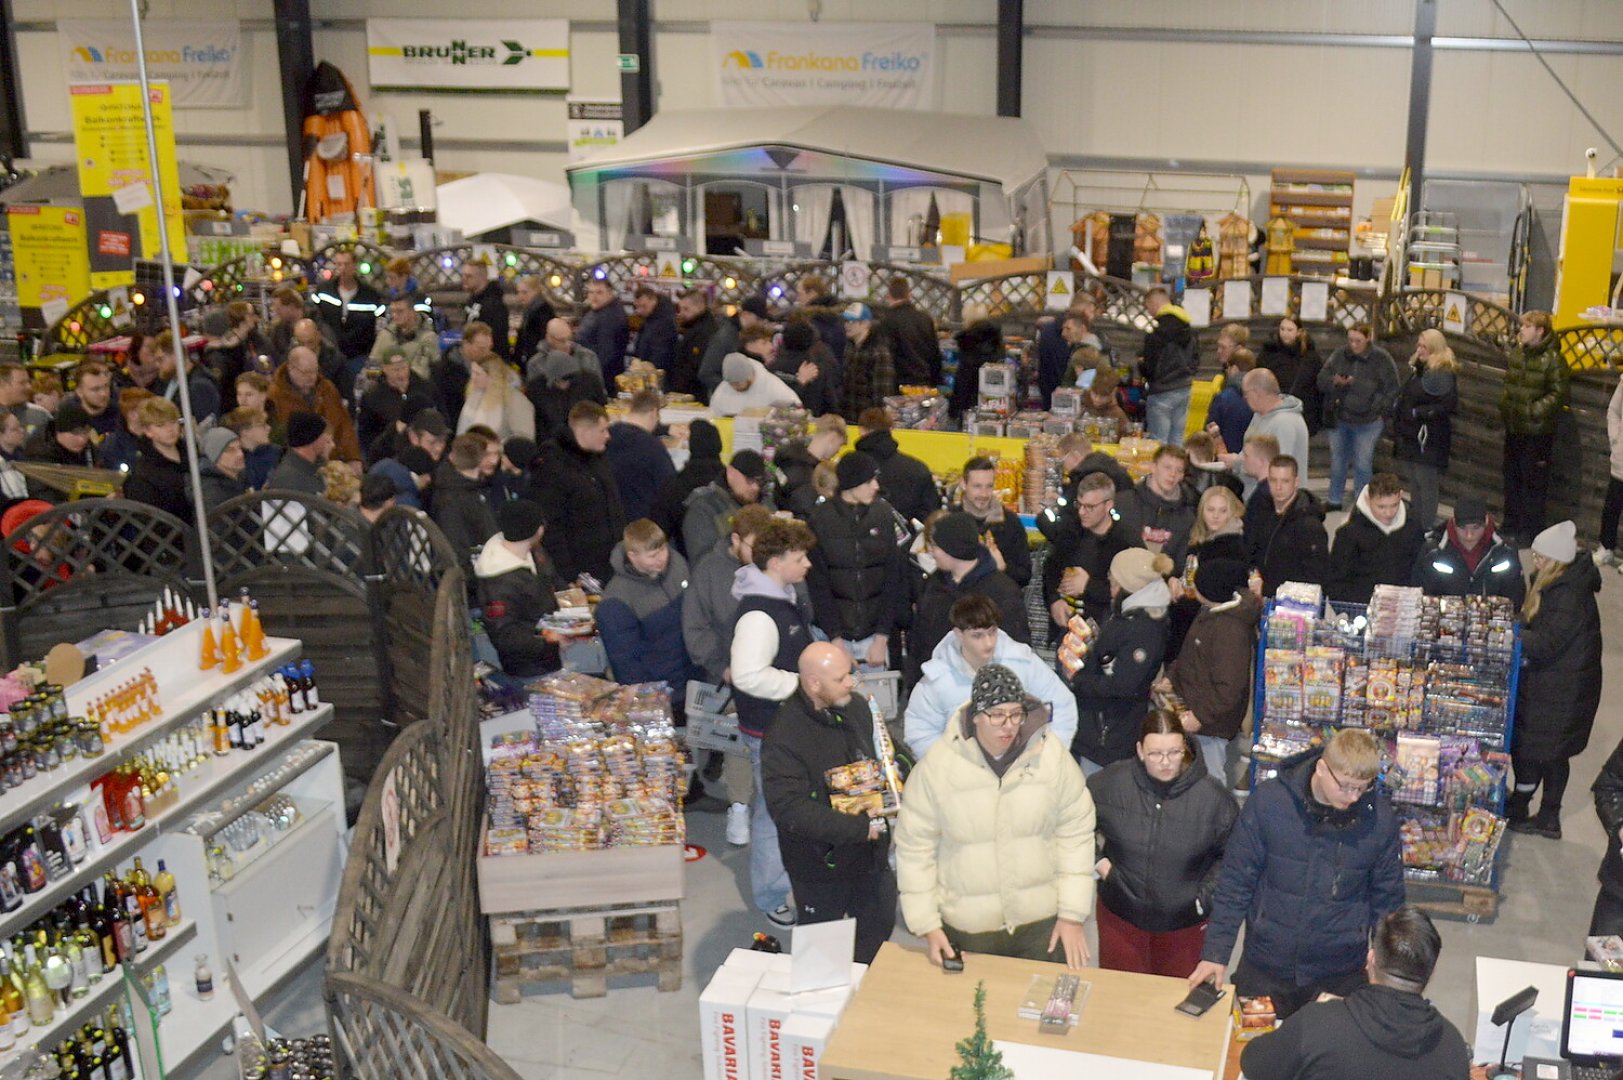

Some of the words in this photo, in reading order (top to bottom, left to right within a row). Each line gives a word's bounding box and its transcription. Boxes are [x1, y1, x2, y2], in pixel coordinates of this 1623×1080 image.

[183, 45, 230, 64] Freiko
[767, 50, 859, 71] Frankana
[861, 51, 920, 71] Freiko
[816, 78, 866, 91] Camping
